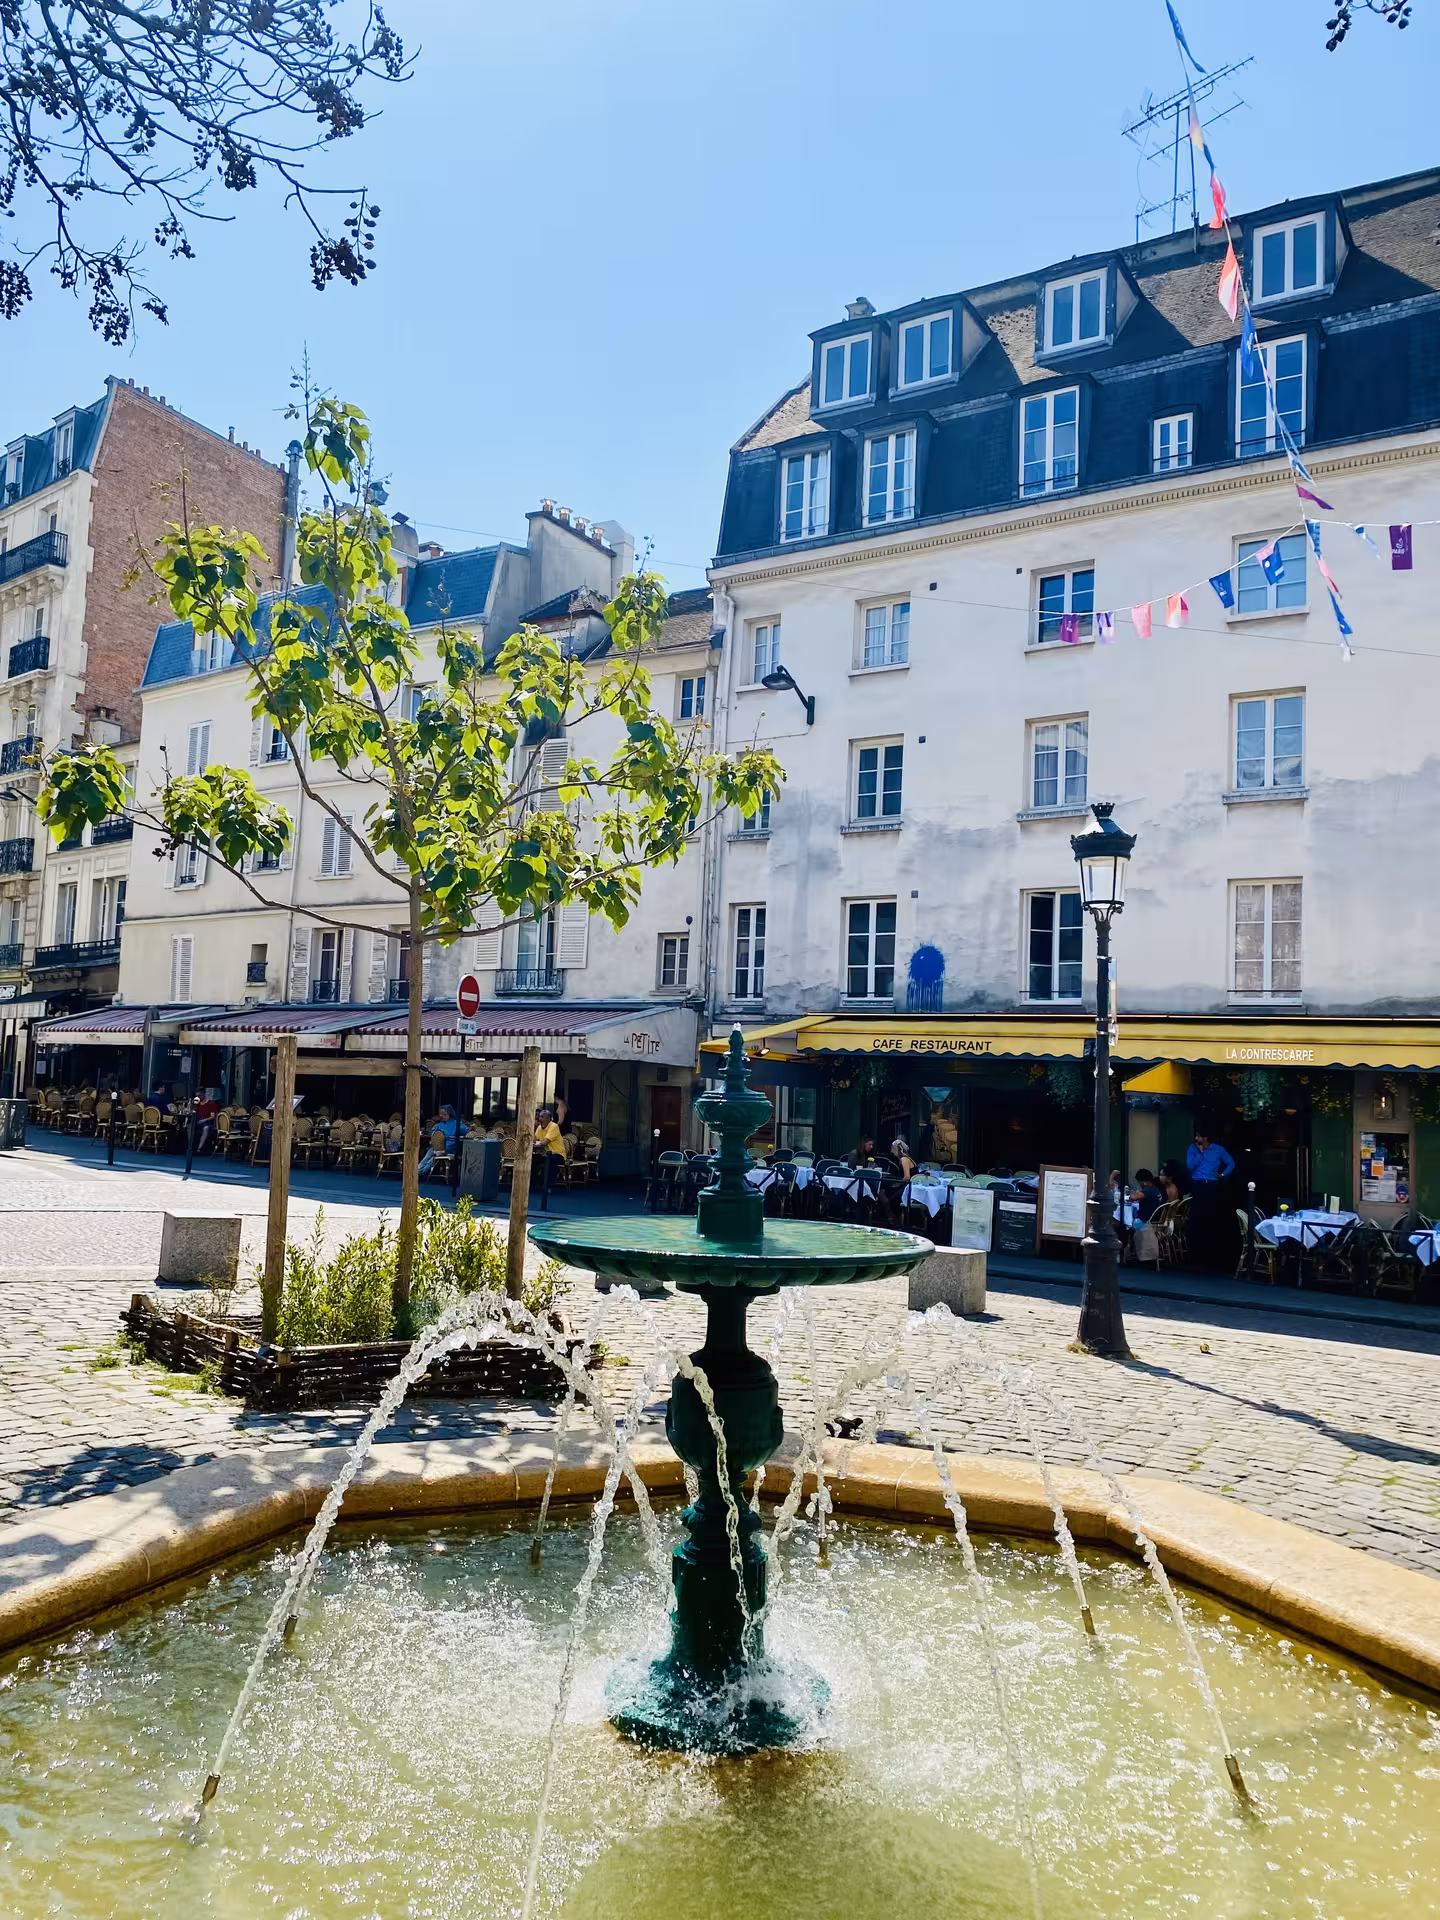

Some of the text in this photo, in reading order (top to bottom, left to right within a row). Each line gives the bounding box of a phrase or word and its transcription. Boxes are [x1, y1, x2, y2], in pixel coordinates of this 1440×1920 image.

[872, 1038, 993, 1052] CAFE RESTAURANT
[1226, 1047, 1315, 1061] LA CONTRESCARPE
